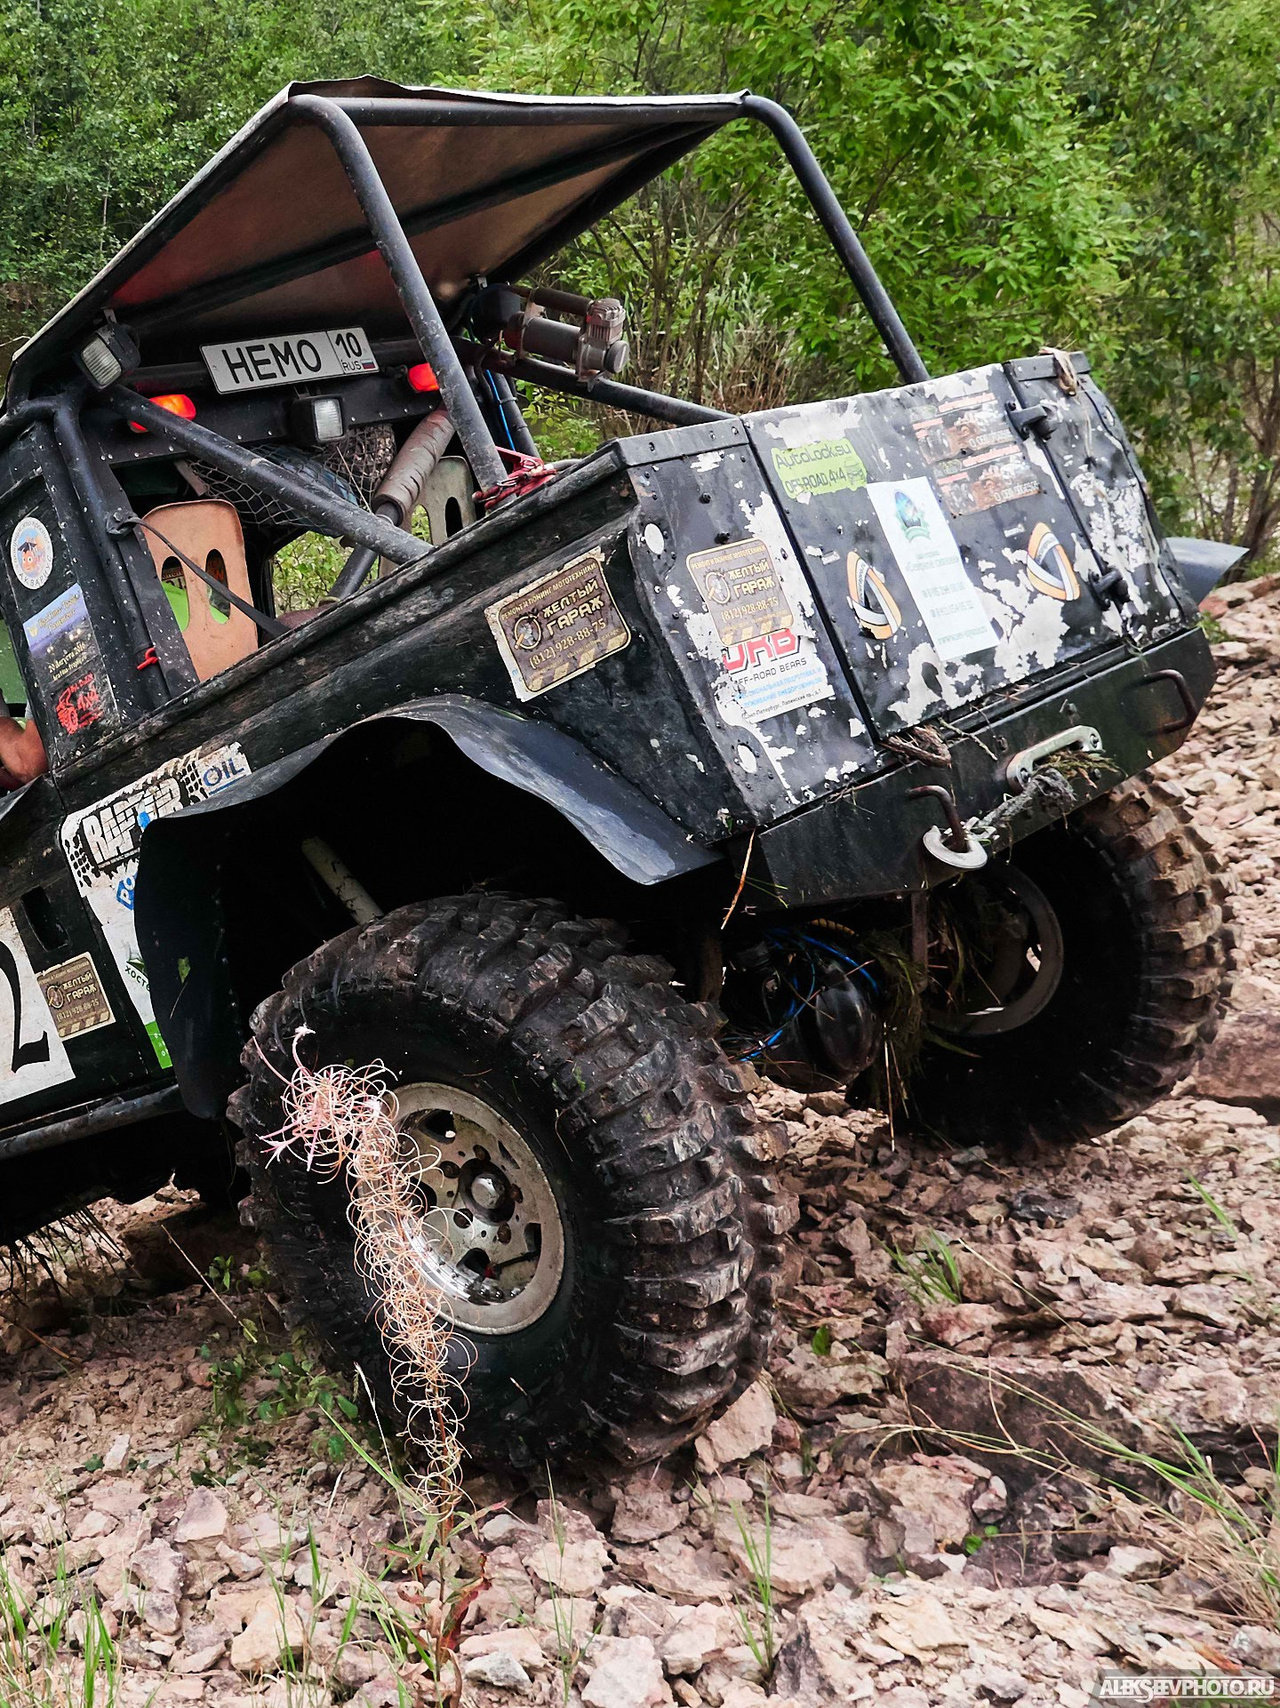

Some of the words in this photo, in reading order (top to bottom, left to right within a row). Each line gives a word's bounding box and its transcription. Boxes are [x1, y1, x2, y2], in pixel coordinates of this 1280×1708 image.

[335, 331, 362, 359] 10
[341, 359, 362, 372] RUS
[775, 443, 852, 469] AutoLock.su
[728, 558, 770, 580] ЖЕЛТЫЙ
[542, 577, 599, 620] ЖЕЛТЫЙ
[733, 575, 776, 599] ГАРАЖ
[546, 595, 605, 637] ГАРАЖ
[721, 606, 743, 624] (812)
[529, 646, 557, 669] (812)
[555, 618, 607, 652] 928-88-75
[738, 667, 777, 686] FF-ROAD
[779, 656, 807, 673] BEARS
[203, 757, 245, 787] OIL
[62, 970, 93, 990] ЖЕЛТЫЙ
[65, 983, 97, 1002] ГАРАЖ
